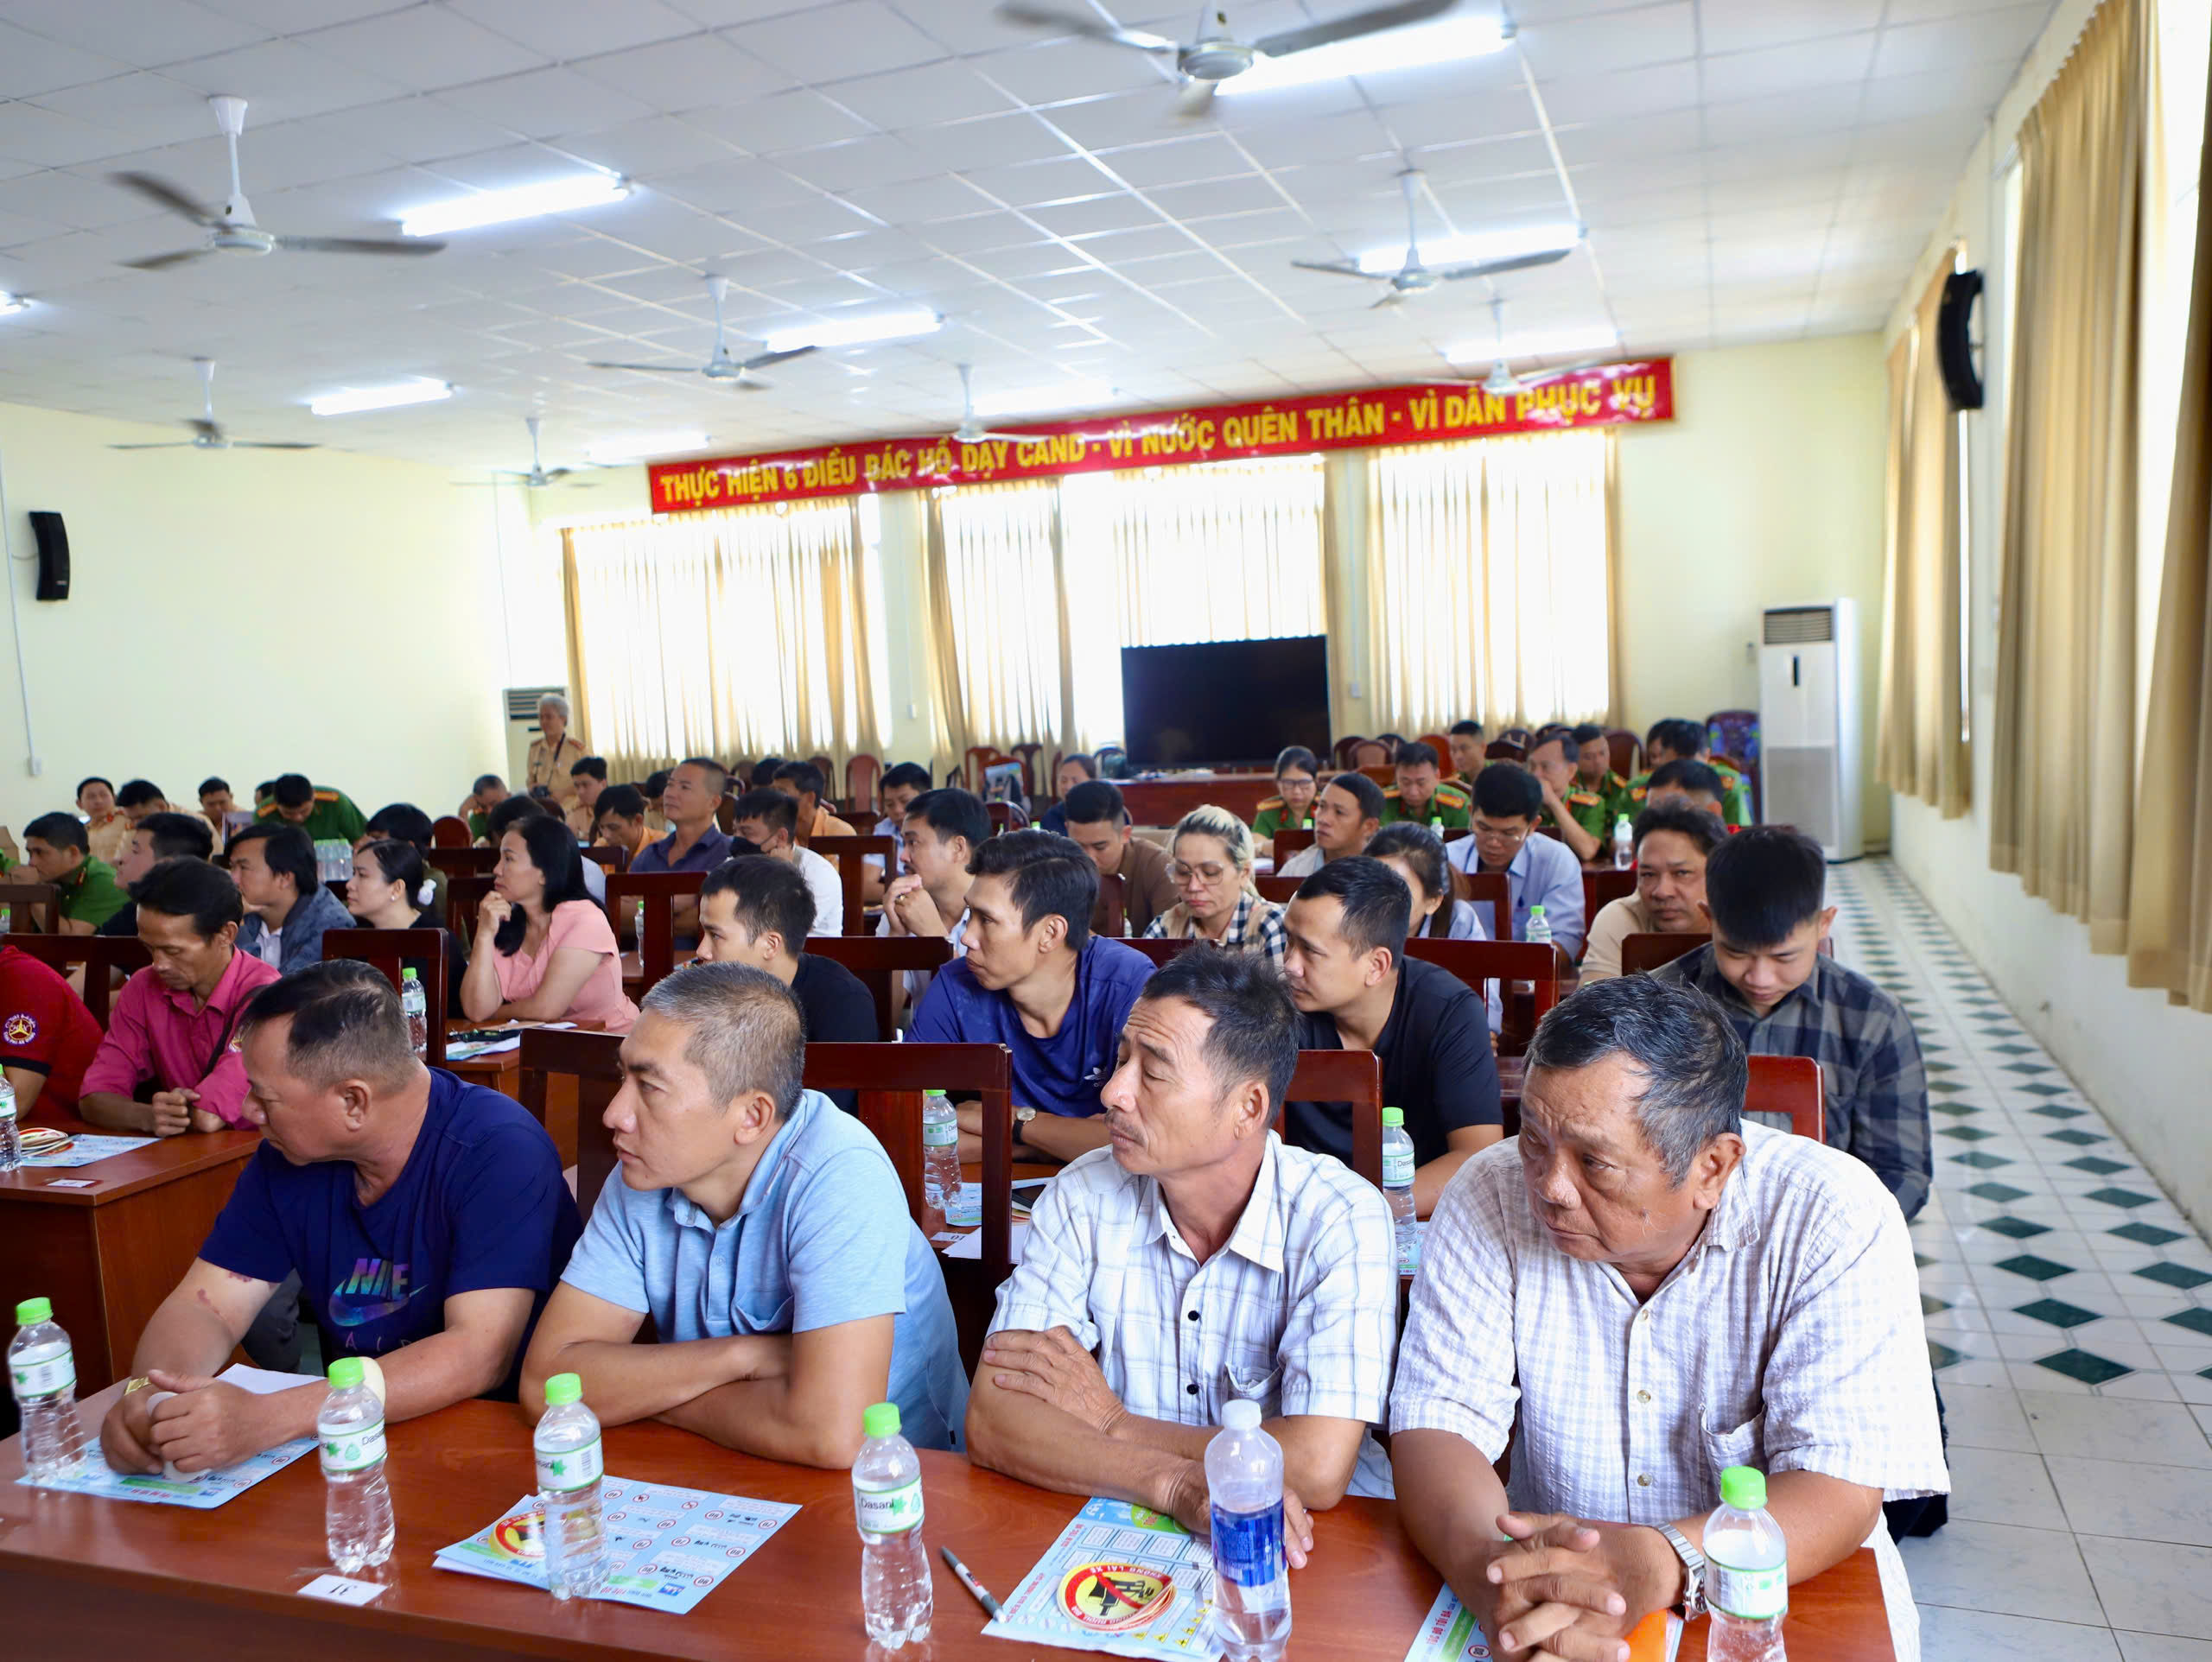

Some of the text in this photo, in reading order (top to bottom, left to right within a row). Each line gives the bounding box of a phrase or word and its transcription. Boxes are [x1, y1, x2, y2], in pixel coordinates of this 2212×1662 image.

[660, 466, 720, 507] THỰC
[726, 459, 779, 501] HIỆN
[784, 464, 798, 491] 6
[803, 447, 857, 489] ĐIỀU
[864, 444, 912, 481] BÁC
[961, 441, 1009, 479] DẠY
[1016, 434, 1086, 468] CAND
[1223, 405, 1298, 448] QUÊN
[1306, 395, 1384, 441] THÂN
[1409, 389, 1438, 430] VÌ
[1445, 386, 1505, 428] DÂN
[1612, 376, 1656, 418] VỤ
[861, 1497, 894, 1510] Dasani
